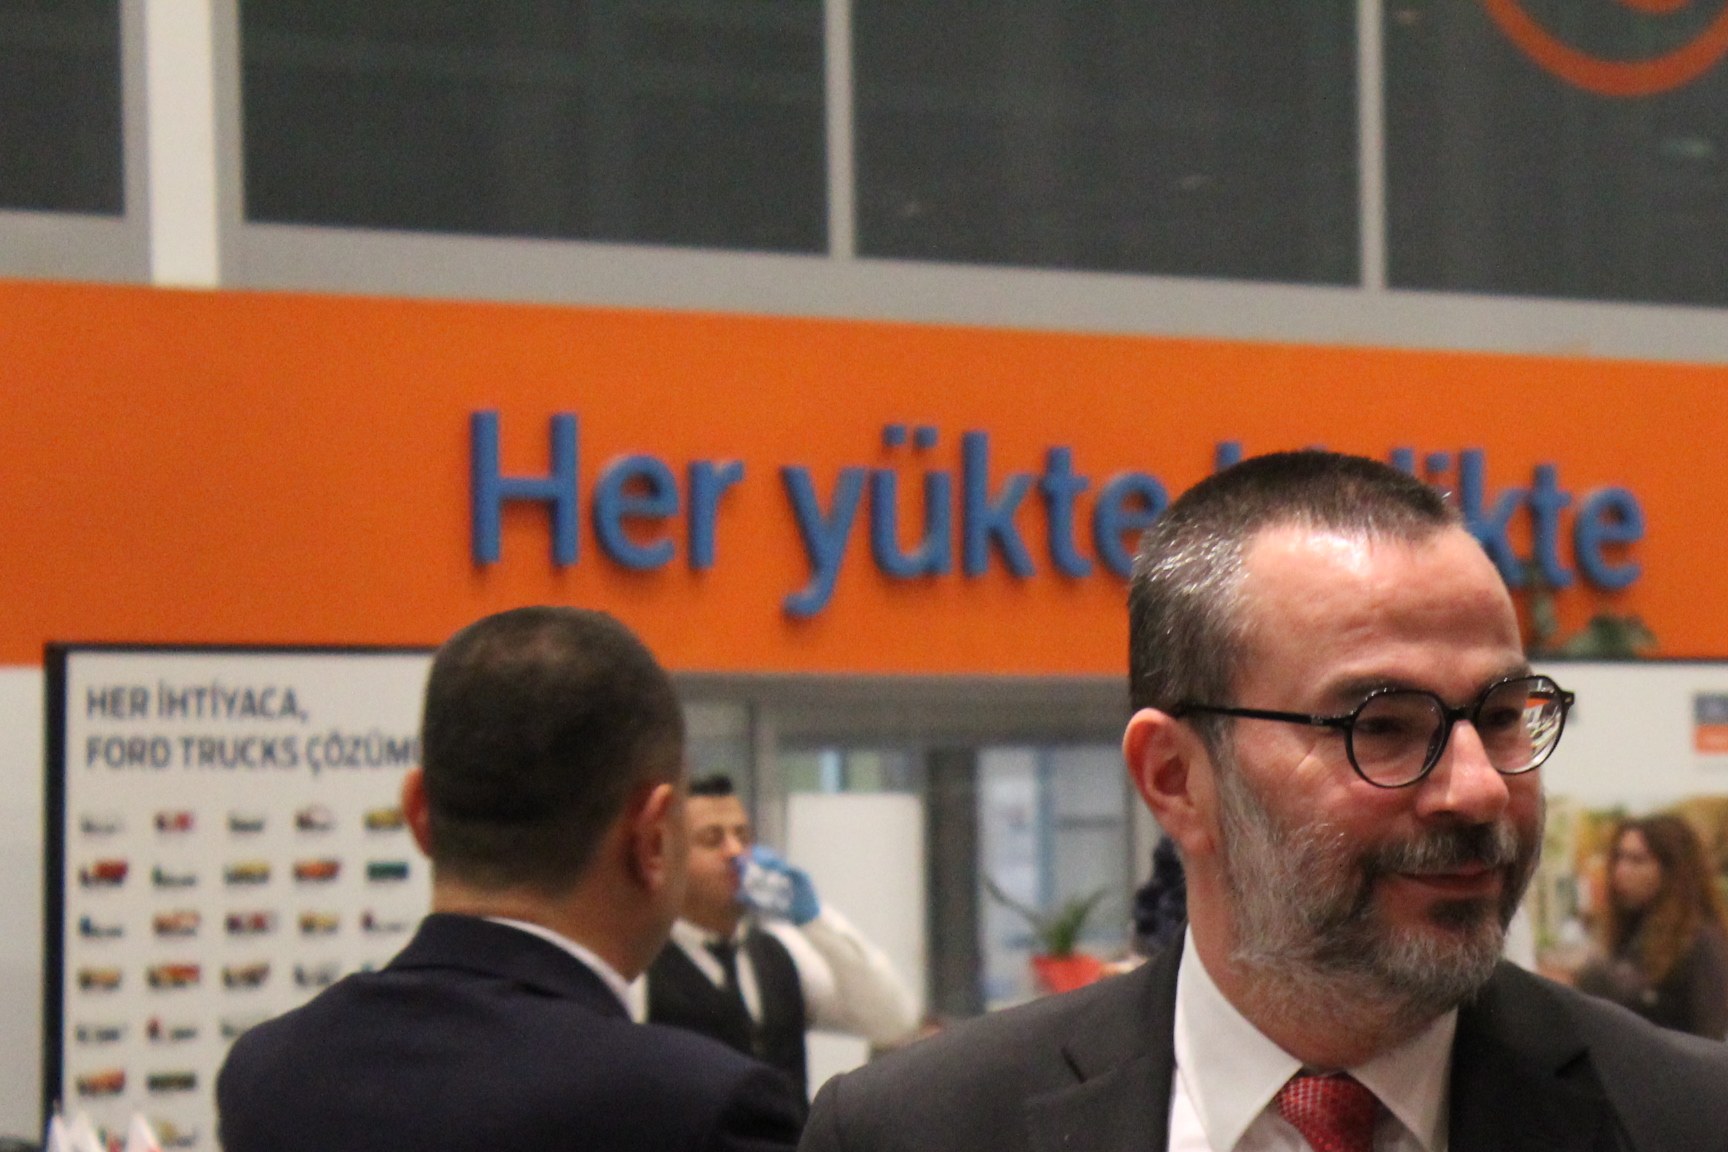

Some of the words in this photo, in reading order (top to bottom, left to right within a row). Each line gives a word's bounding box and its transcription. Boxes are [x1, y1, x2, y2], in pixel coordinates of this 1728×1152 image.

[470, 410, 744, 570] Her
[780, 424, 1168, 618] yükte
[86, 686, 149, 719] HER
[157, 681, 309, 724] İHTİYACA,
[86, 737, 171, 769] FORD
[179, 737, 298, 769] TRUCKS
